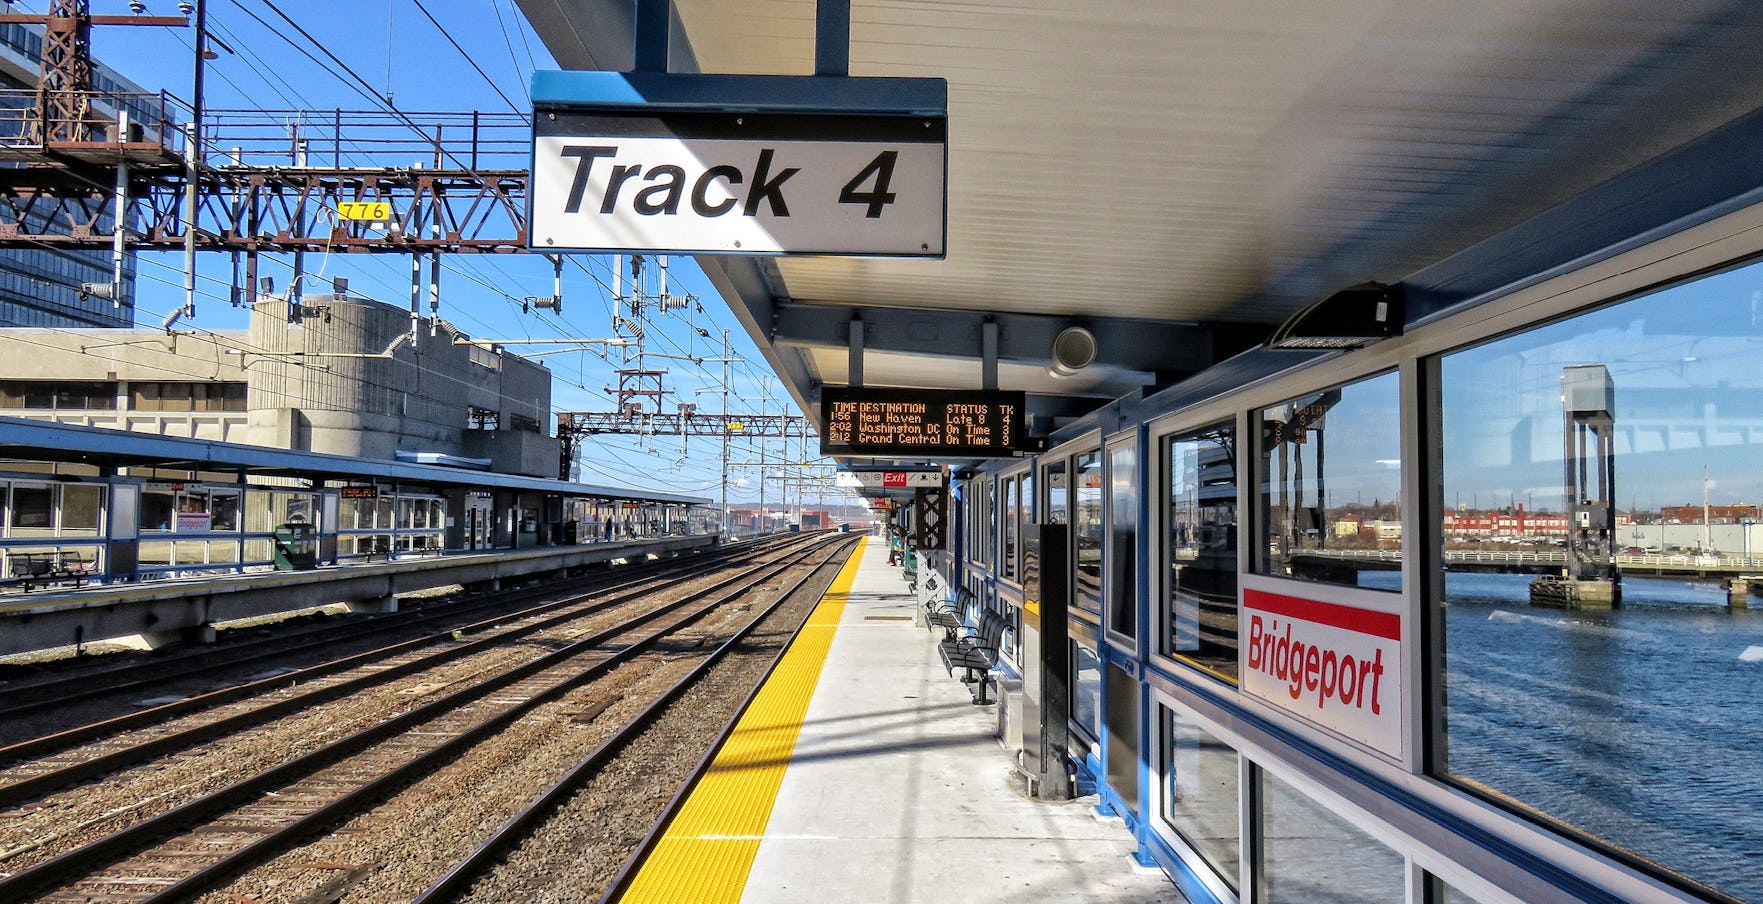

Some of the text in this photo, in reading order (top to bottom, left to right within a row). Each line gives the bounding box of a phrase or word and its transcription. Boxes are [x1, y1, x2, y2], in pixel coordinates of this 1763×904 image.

[561, 145, 899, 218] Track 4
[343, 204, 383, 218] 776
[832, 402, 1014, 415] TIME DESTINATION STATUS TK
[831, 411, 1010, 425] 1:56 New Haven Late 8 4
[829, 421, 1010, 435] 2:02 Washington DC On Time 3
[829, 432, 1010, 446] 2:12 Grand Central On Time 3
[884, 473, 905, 483] Exit
[1248, 614, 1384, 716] Bridgeport
